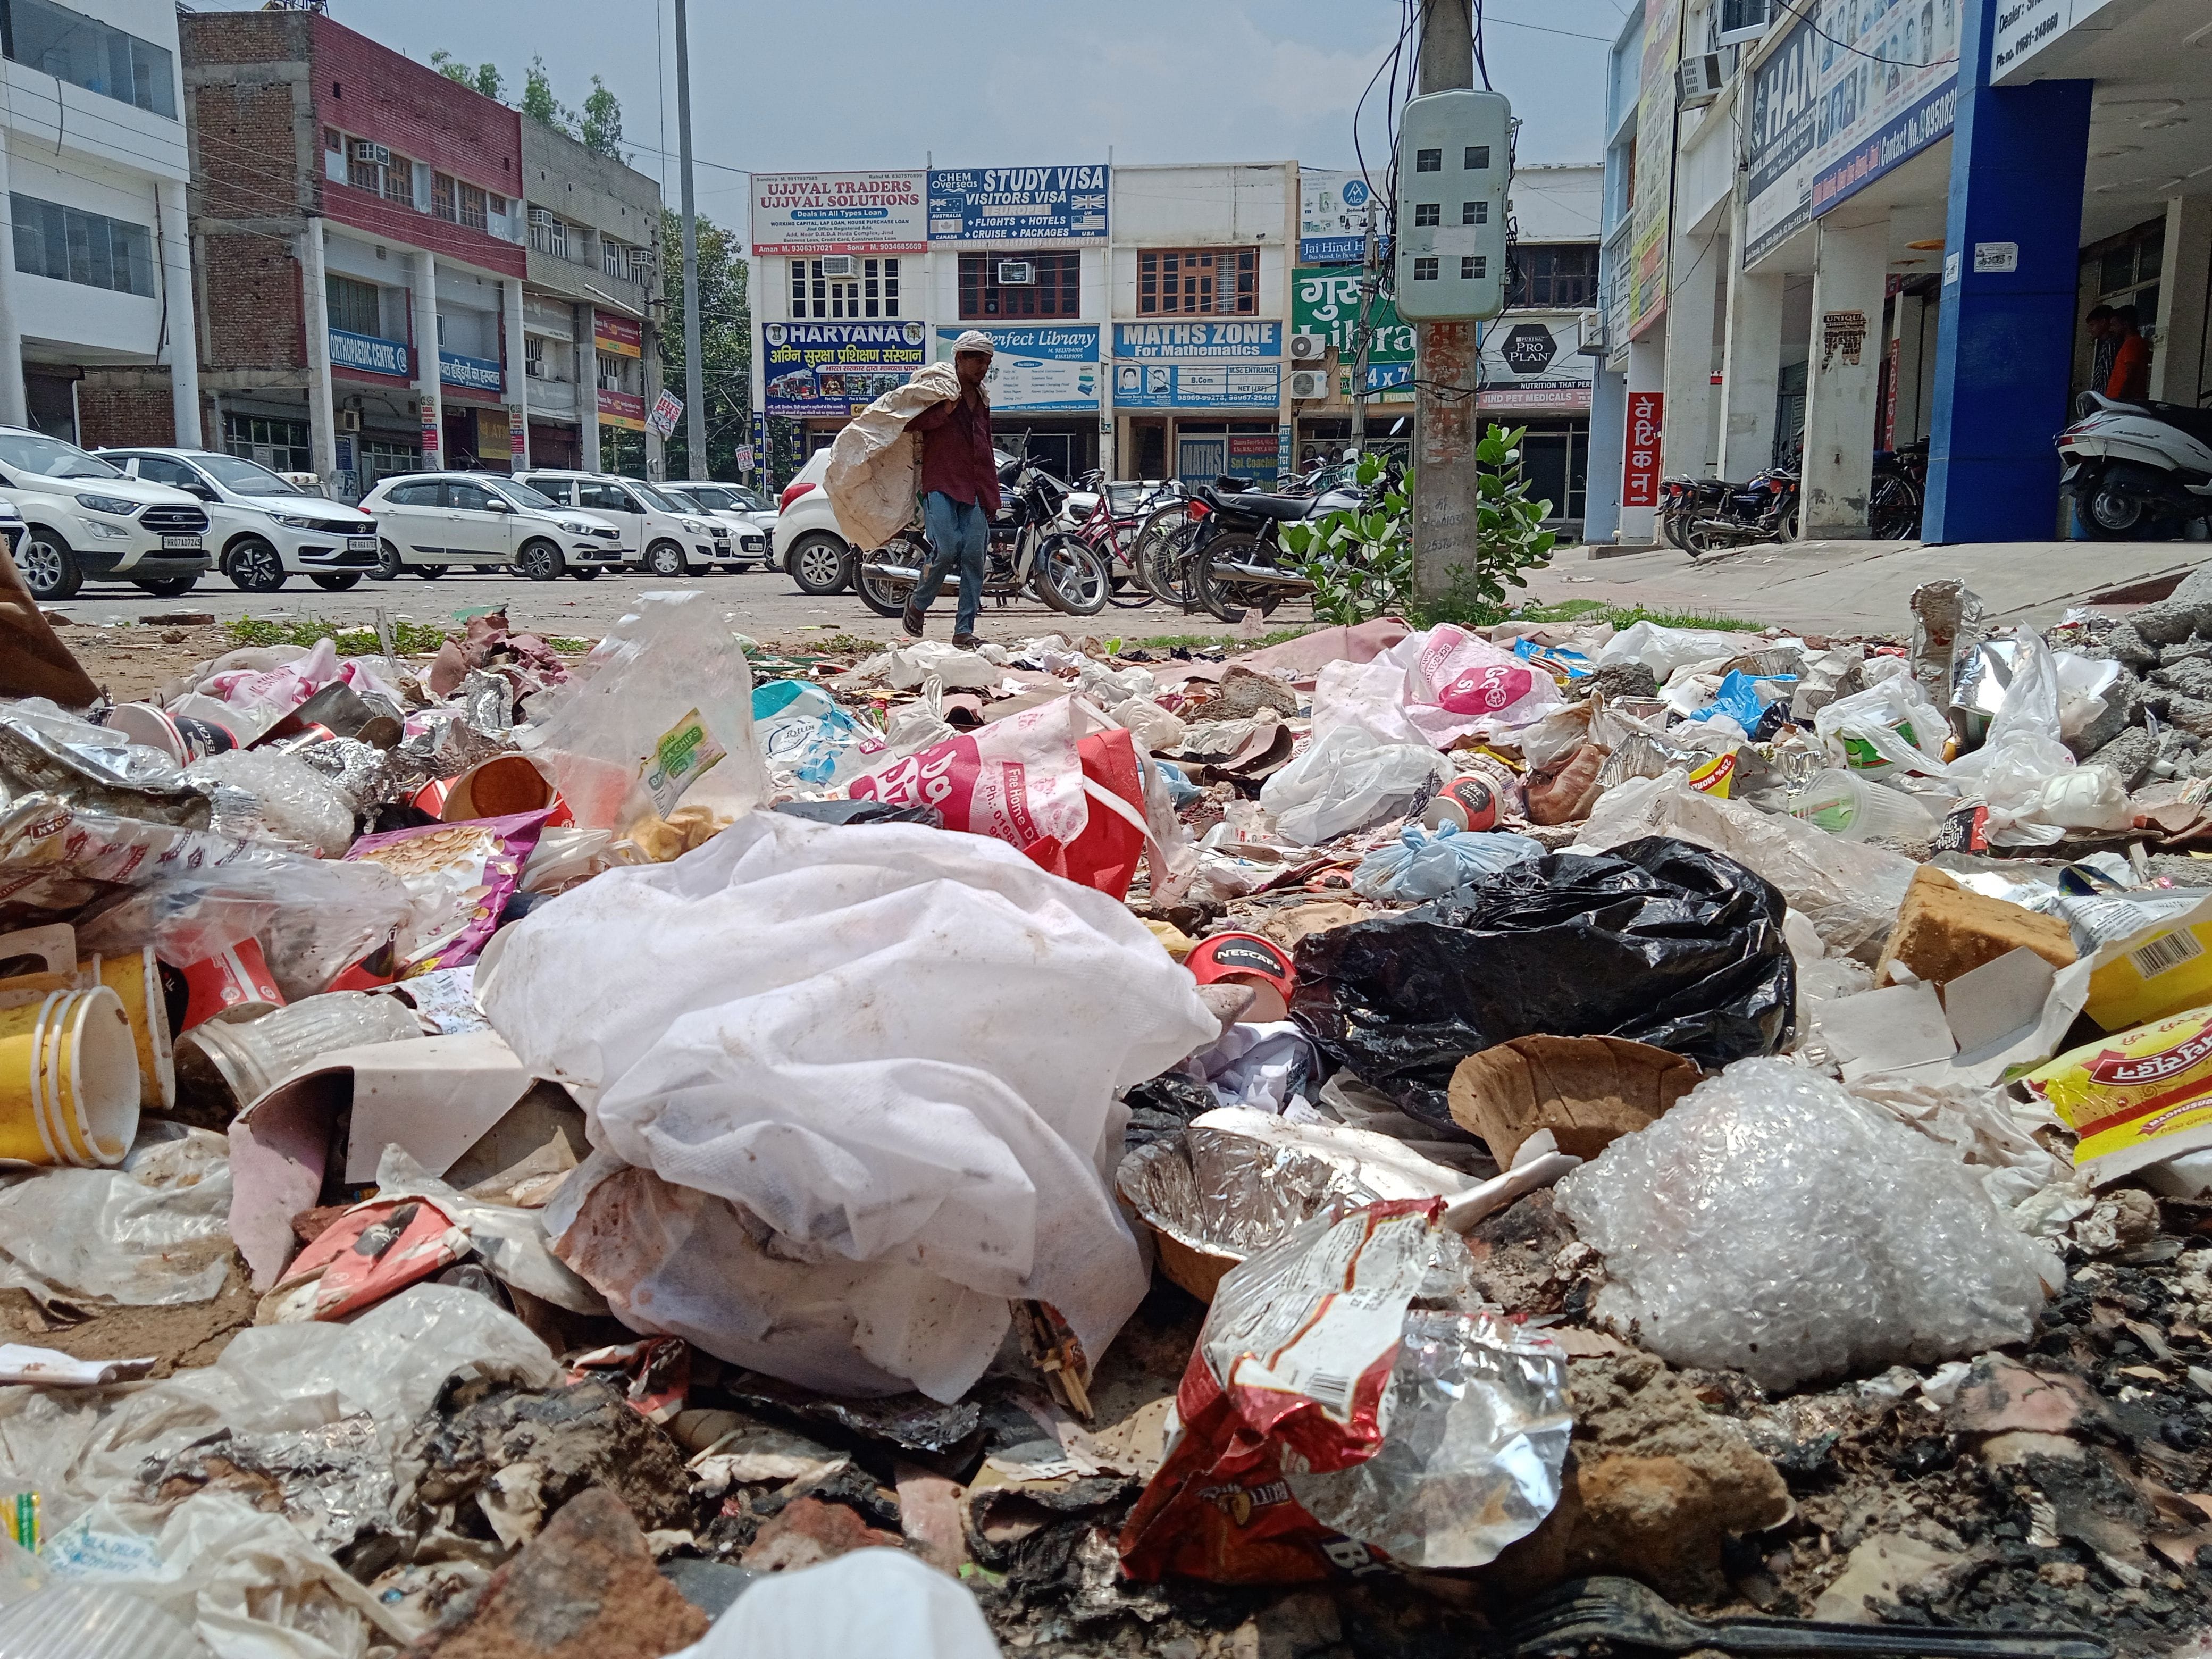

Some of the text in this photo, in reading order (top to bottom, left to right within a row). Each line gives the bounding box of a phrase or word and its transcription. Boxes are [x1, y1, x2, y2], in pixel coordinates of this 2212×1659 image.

[1881, 125, 1907, 167] Contact
[938, 173, 971, 182] CHEM
[984, 167, 1104, 192] STUDY VISA
[768, 180, 911, 195] UJJVAL TRADERS
[760, 194, 919, 208] UJJVAL SOLUTIONS
[966, 191, 1067, 205] VISITORS VISA
[992, 206, 1042, 215] EUROPE
[975, 217, 1015, 227] FLIGHTS
[1028, 216, 1066, 225] HOTELS
[1019, 228, 1069, 237] PACKAGES
[1304, 242, 1350, 255] Jai Hind
[791, 326, 901, 342] HARYANA
[984, 331, 1095, 348] Perfect Library
[1124, 323, 1273, 345] MATHS ZONE
[330, 334, 396, 370] ORTHOPAEDIC CENTRE
[1135, 344, 1260, 356] For Mathematics
[1516, 342, 1543, 352] PRO
[770, 344, 923, 368] अग्नि सुरक्षा प्रशिक्षण संस्थान
[1509, 352, 1548, 362] PLAN
[1526, 393, 1572, 402] MEDICALS
[659, 398, 680, 415] IELTS
[1183, 444, 1221, 475] MATHS
[674, 728, 699, 751] CHIPS
[1715, 758, 1732, 776] 25%
[1008, 768, 1025, 826] Free Home
[2161, 1122, 2185, 1134] DESI
